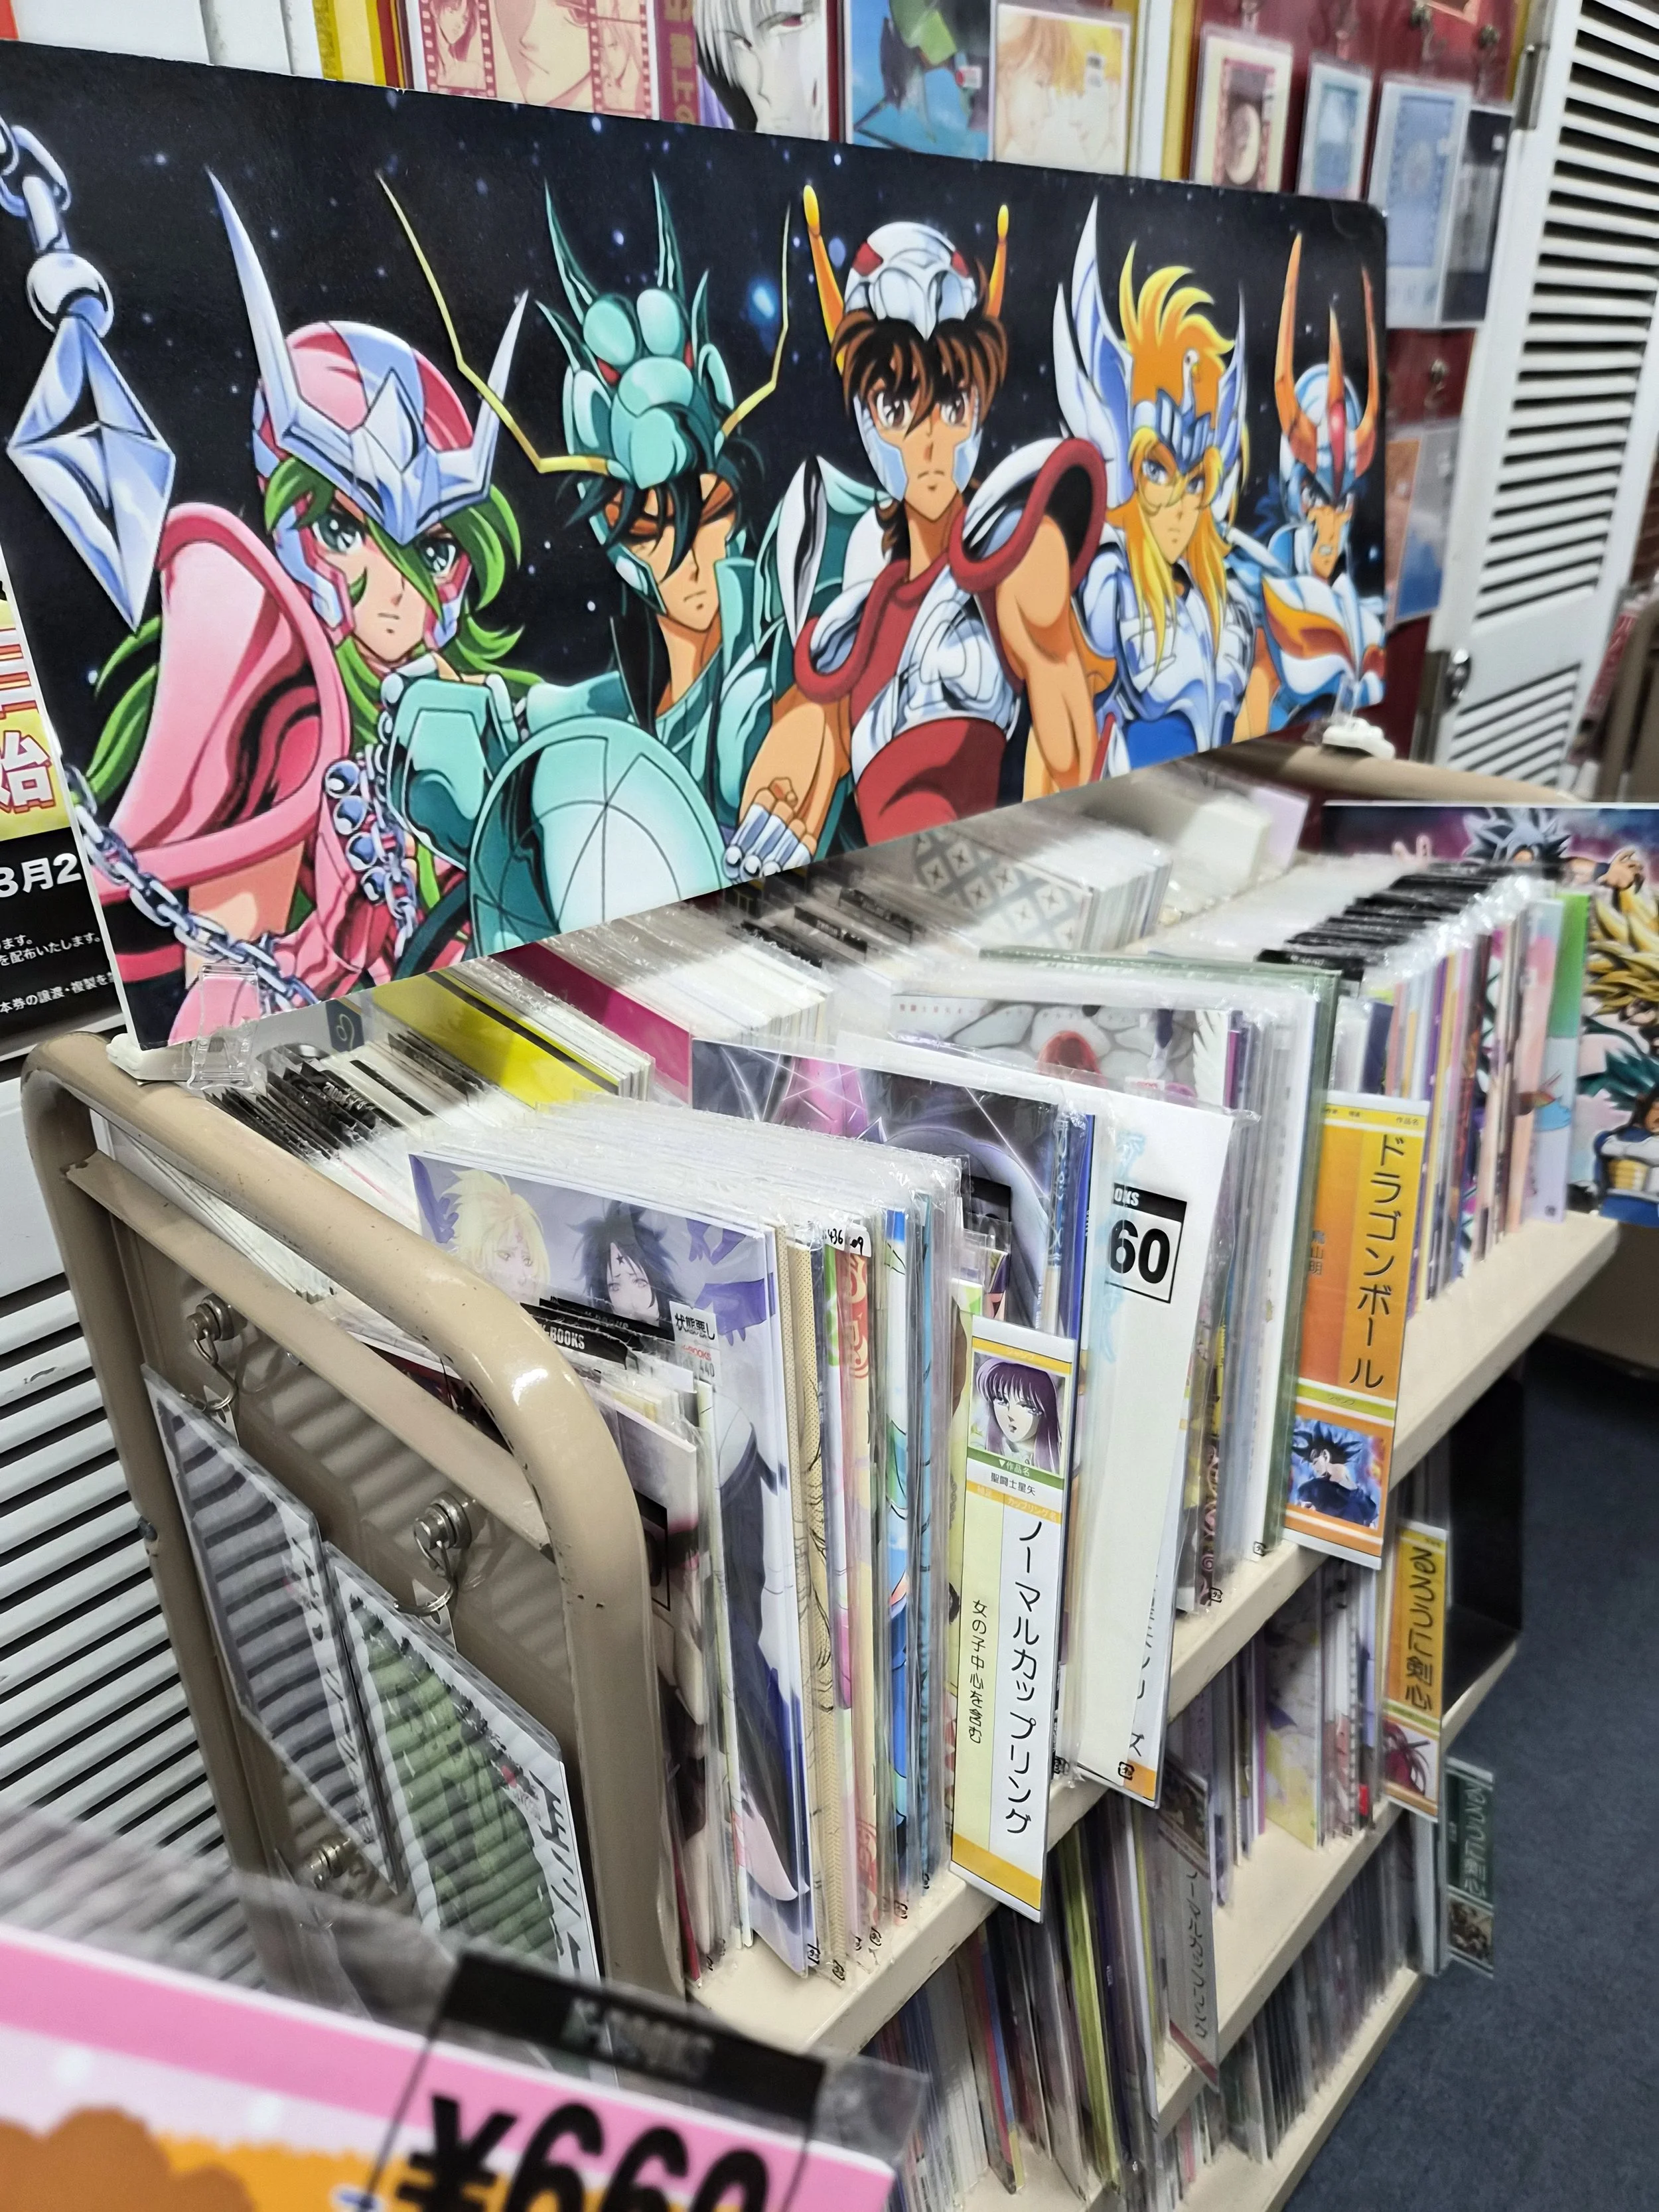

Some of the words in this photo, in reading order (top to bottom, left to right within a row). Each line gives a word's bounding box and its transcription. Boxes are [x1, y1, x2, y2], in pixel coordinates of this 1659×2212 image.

[0, 934, 33, 950] ます。
[1350, 1134, 1405, 1388] ドラゴンボール
[991, 1471, 1037, 1497] 聖闘士星矢
[968, 1599, 987, 1744] 女の子中心を含む
[1005, 1520, 1043, 1834] ノーマルカップリング
[1405, 1546, 1436, 1711] るろうに剣心
